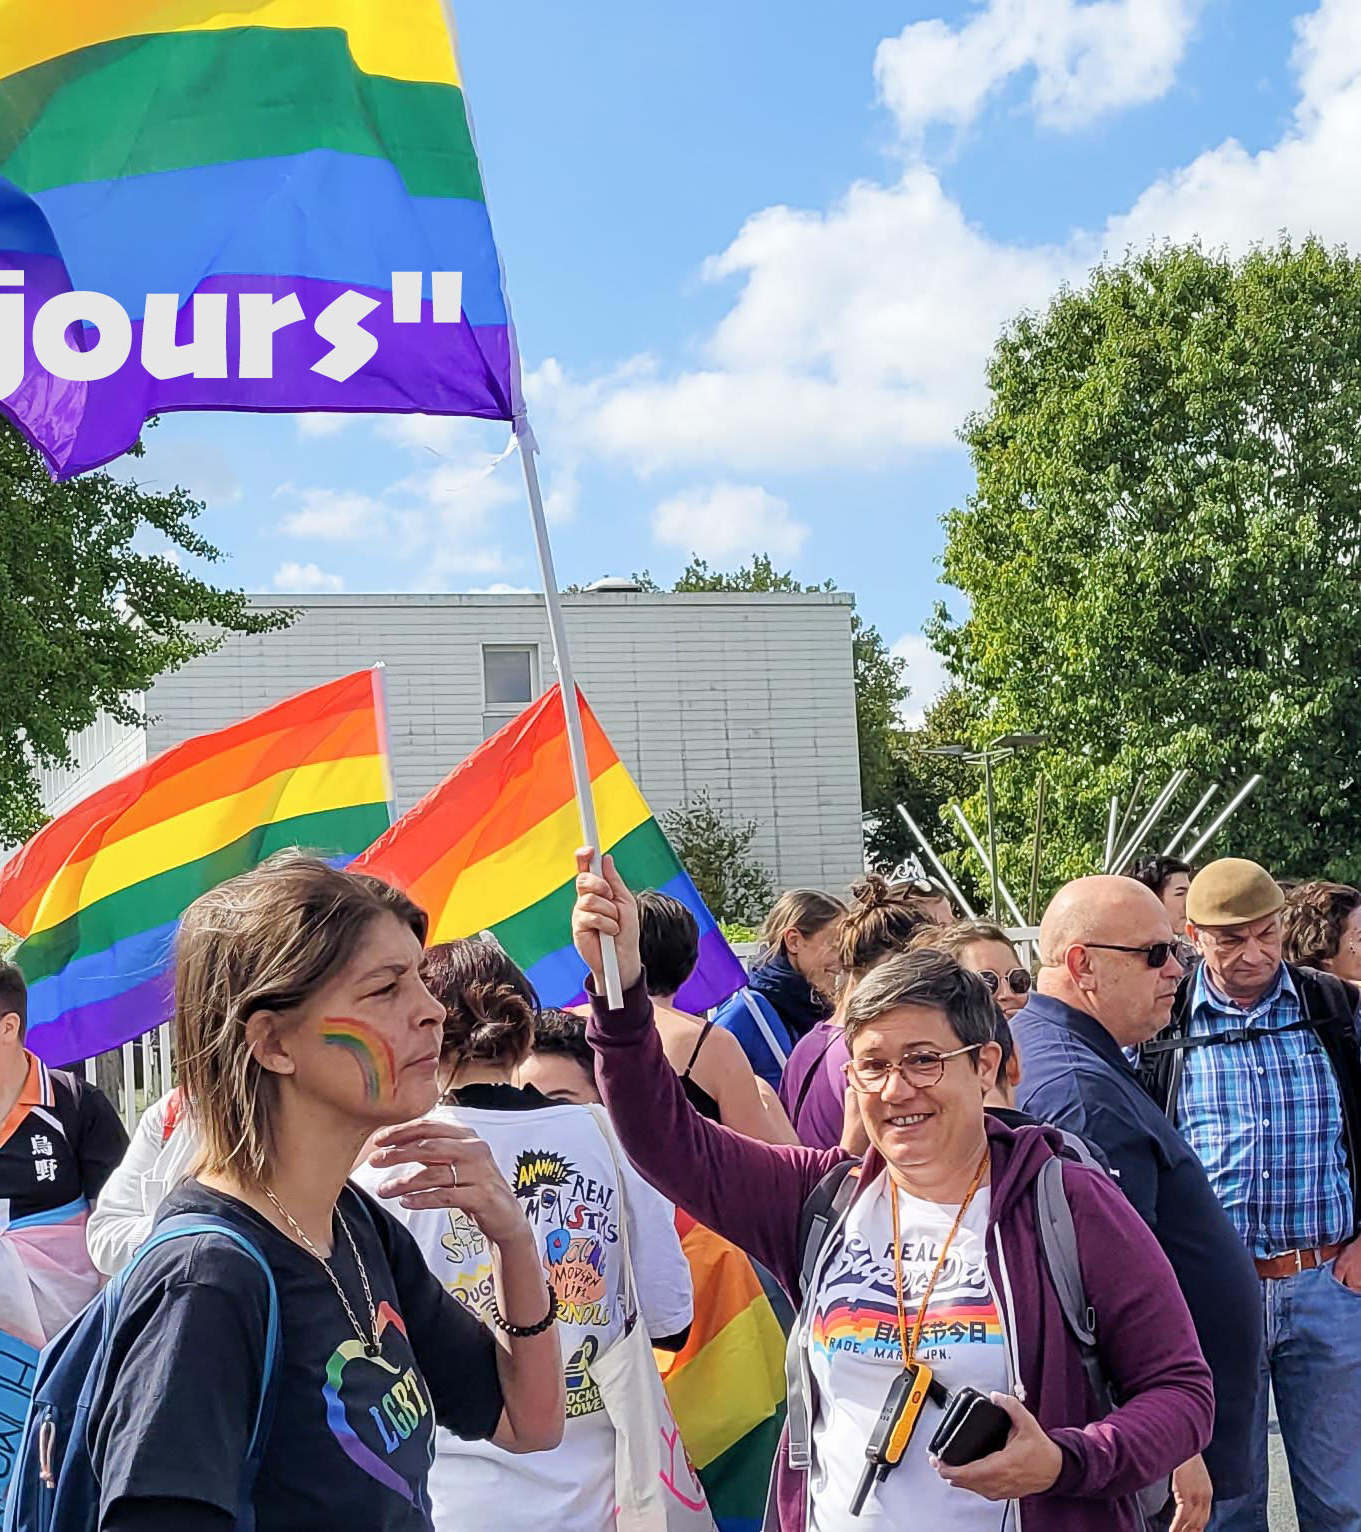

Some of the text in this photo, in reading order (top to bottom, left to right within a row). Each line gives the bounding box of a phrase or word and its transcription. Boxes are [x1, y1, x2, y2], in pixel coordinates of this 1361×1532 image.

[572, 1174, 615, 1212] REAL
[883, 1242, 940, 1262] REAL
[554, 1266, 601, 1288] MODERN
[874, 1347, 914, 1360] MAR
[368, 1367, 428, 1455] LGBT
[566, 1397, 604, 1416] POWE
